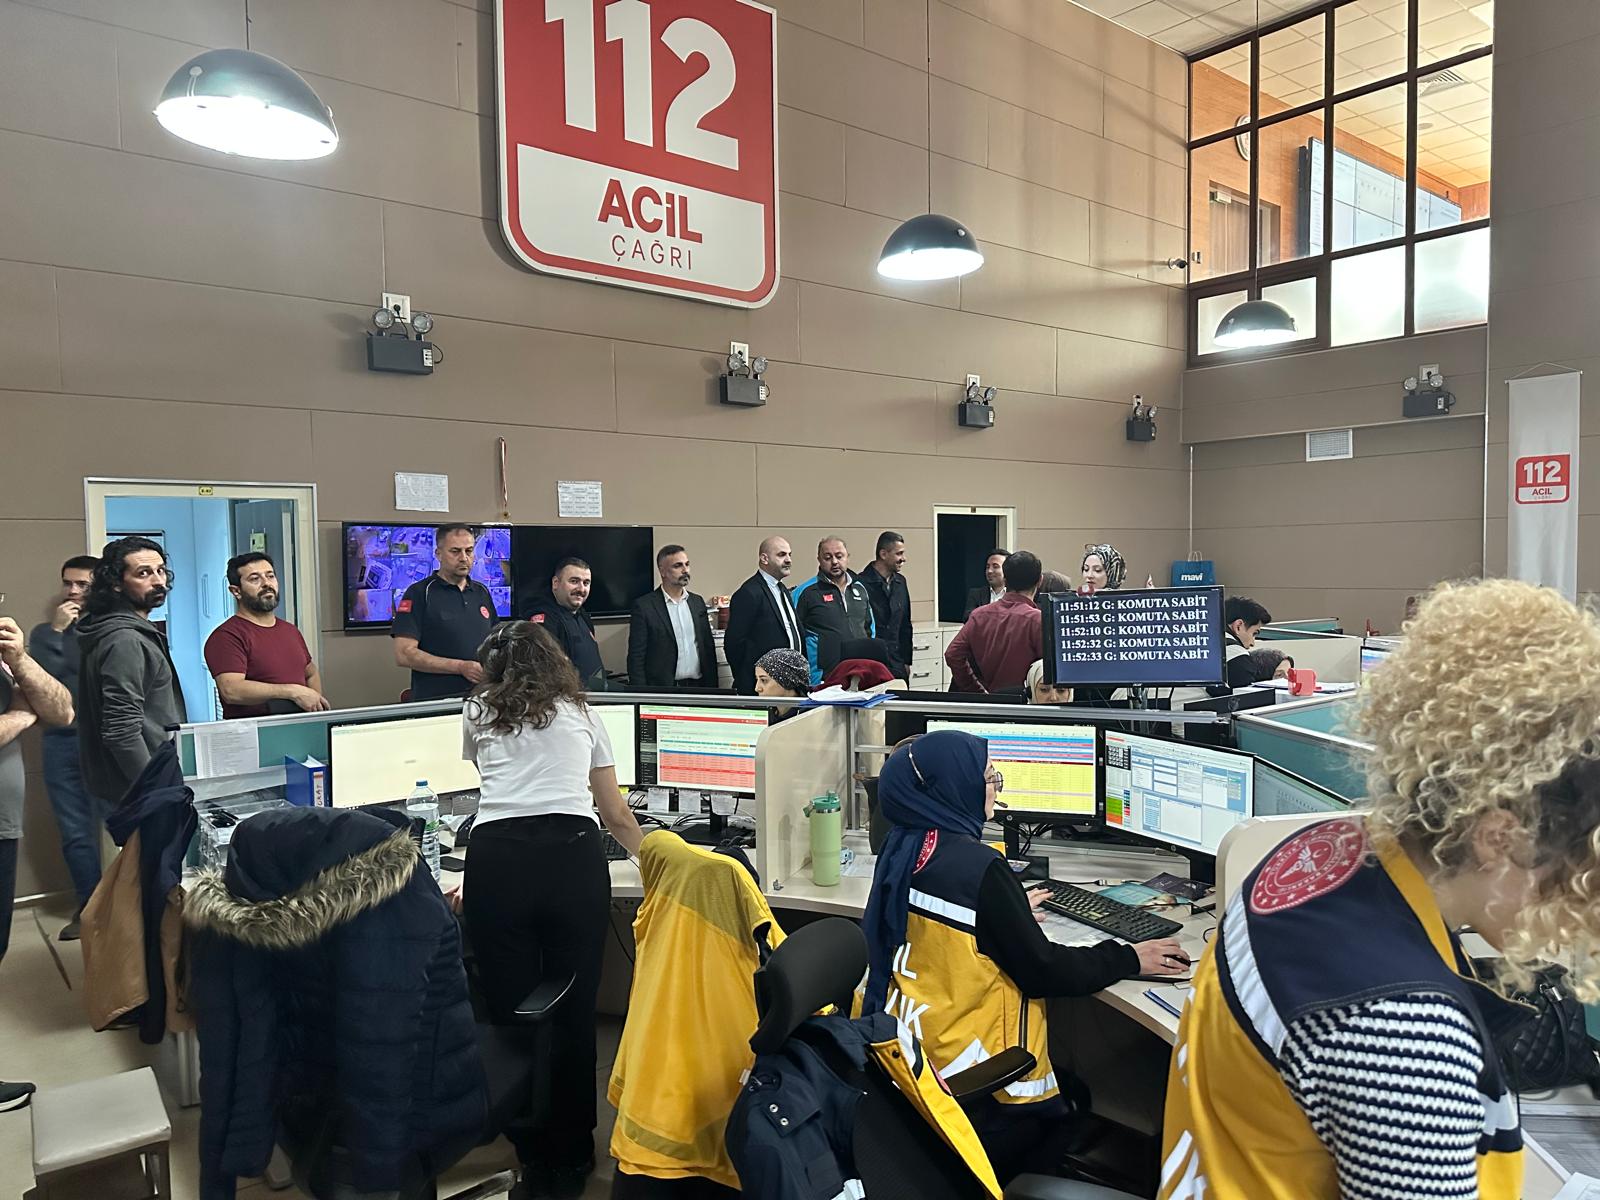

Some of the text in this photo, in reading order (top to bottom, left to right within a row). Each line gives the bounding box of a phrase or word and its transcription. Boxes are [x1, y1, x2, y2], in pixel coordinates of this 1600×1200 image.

[545, 0, 739, 171] 112
[611, 234, 692, 270] ÇAĞRI
[1524, 461, 1561, 483] 112
[1181, 572, 1203, 581] mavi
[1061, 595, 1207, 611] 11:51:12 G: KOMUTA SABİT
[1061, 609, 1208, 623] 11:51:53 G: KOMUTA SABİT
[1061, 622, 1208, 636] 11:52:10 G: KOMUTA SABİT
[1062, 635, 1209, 648] 11:52:32 G: KOMUTA SABİT
[1063, 648, 1209, 661] 11:52:33 G: KOMUTA SABİT
